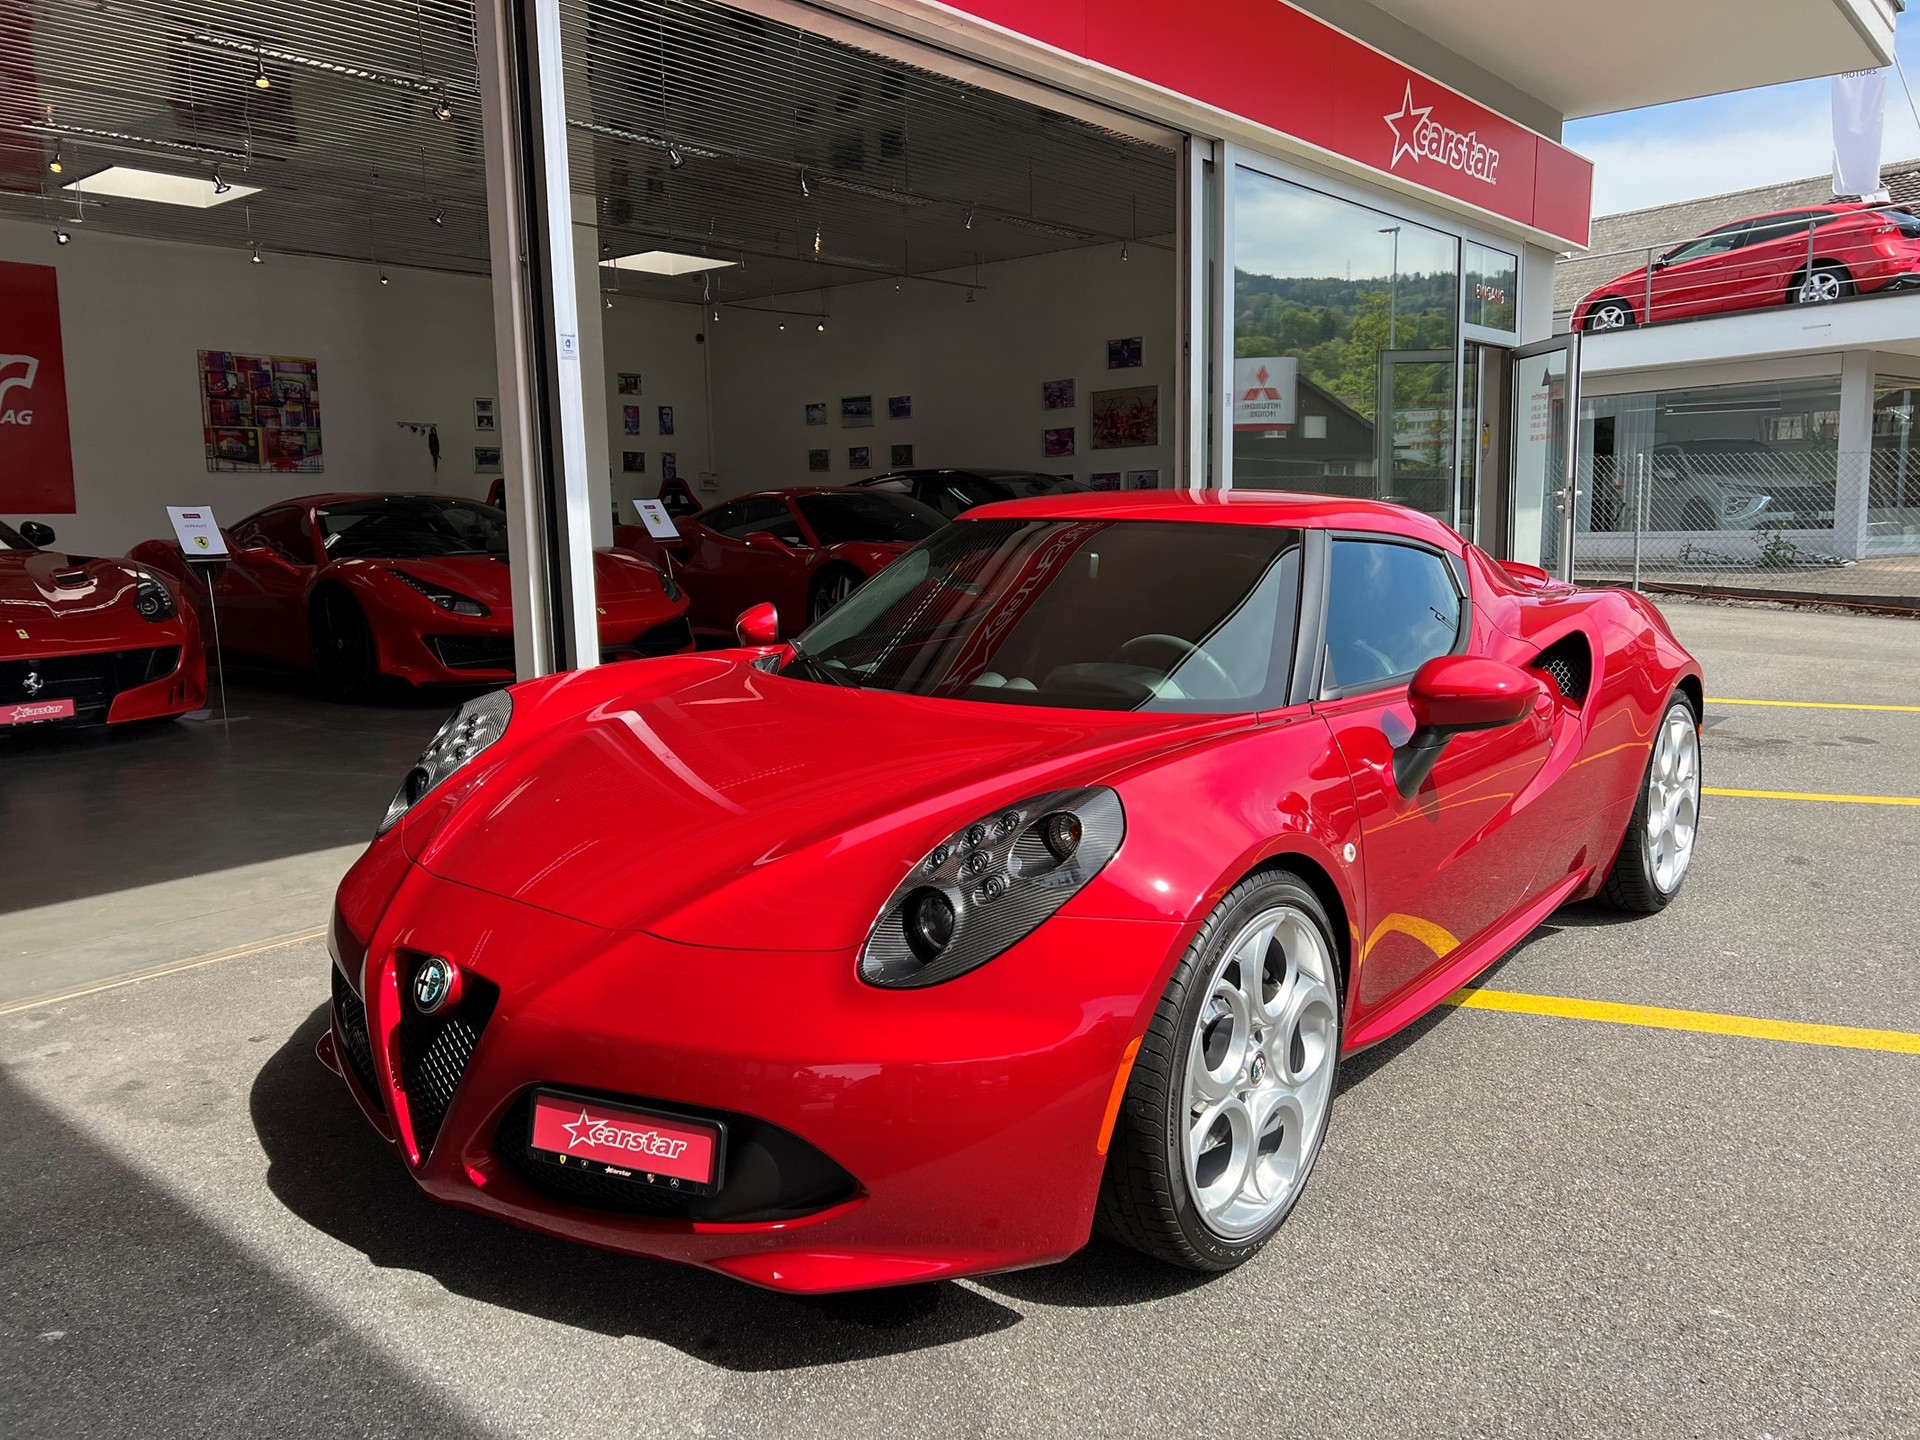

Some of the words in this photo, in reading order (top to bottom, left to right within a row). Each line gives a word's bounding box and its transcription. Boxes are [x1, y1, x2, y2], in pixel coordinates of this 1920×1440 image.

[1841, 68, 1878, 79] MOTORS
[1414, 118, 1500, 184] carstar
[0, 409, 33, 425] AG
[23, 705, 63, 717] carstar
[592, 1125, 688, 1160] carstar
